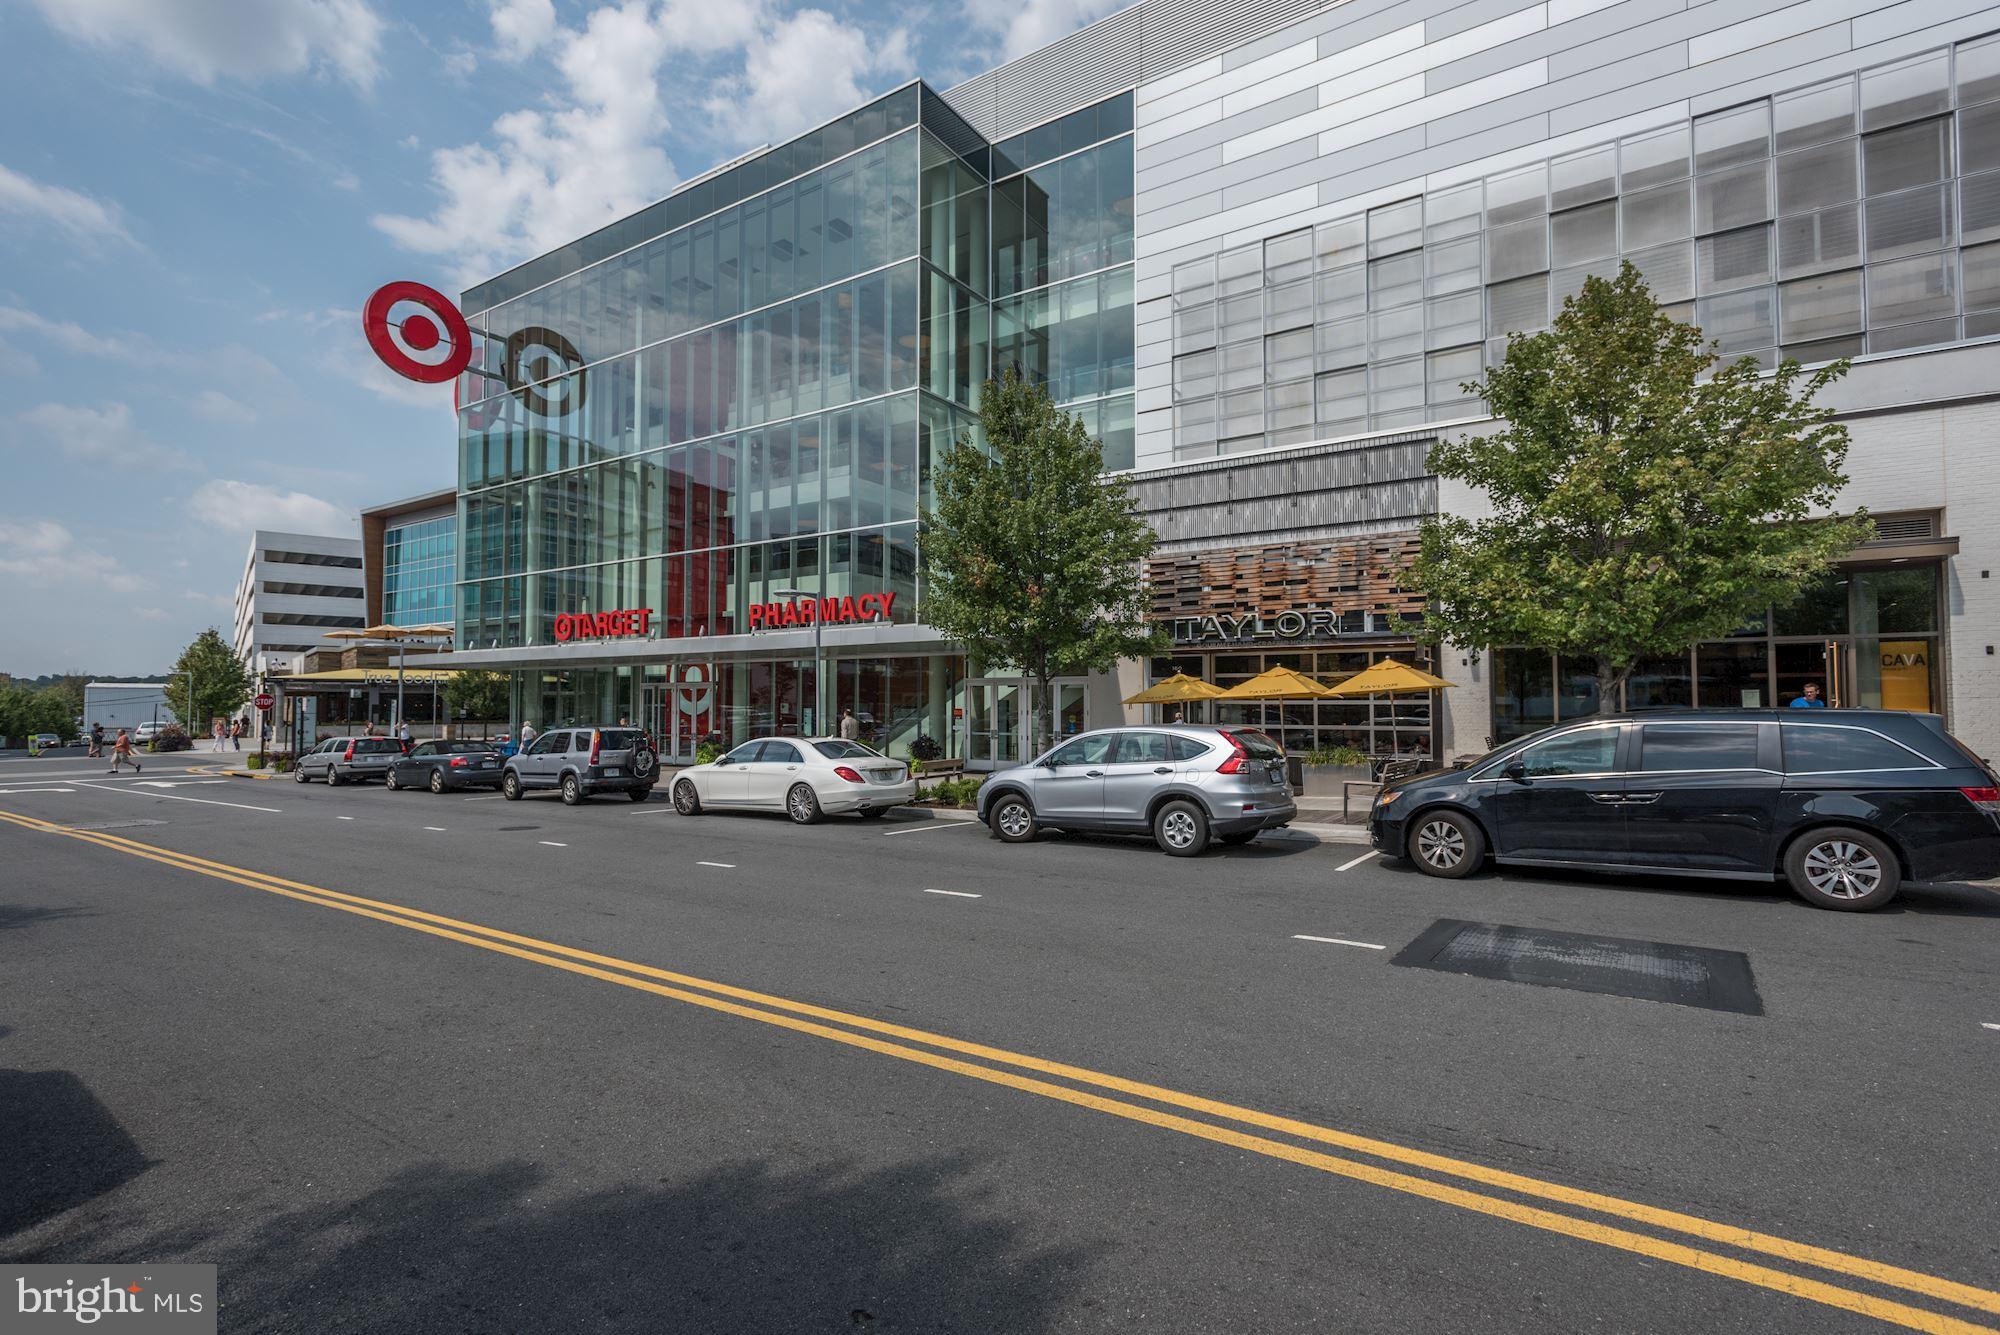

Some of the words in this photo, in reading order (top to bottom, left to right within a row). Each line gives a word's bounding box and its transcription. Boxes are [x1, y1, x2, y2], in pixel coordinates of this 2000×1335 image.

[748, 592, 896, 627] PHARMACY
[568, 608, 653, 638] TARGET
[1176, 609, 1338, 641] TAYLOR
[1881, 653, 1926, 666] CAVA
[361, 669, 393, 684] True
[397, 670, 433, 684] ood
[255, 698, 274, 706] STOP
